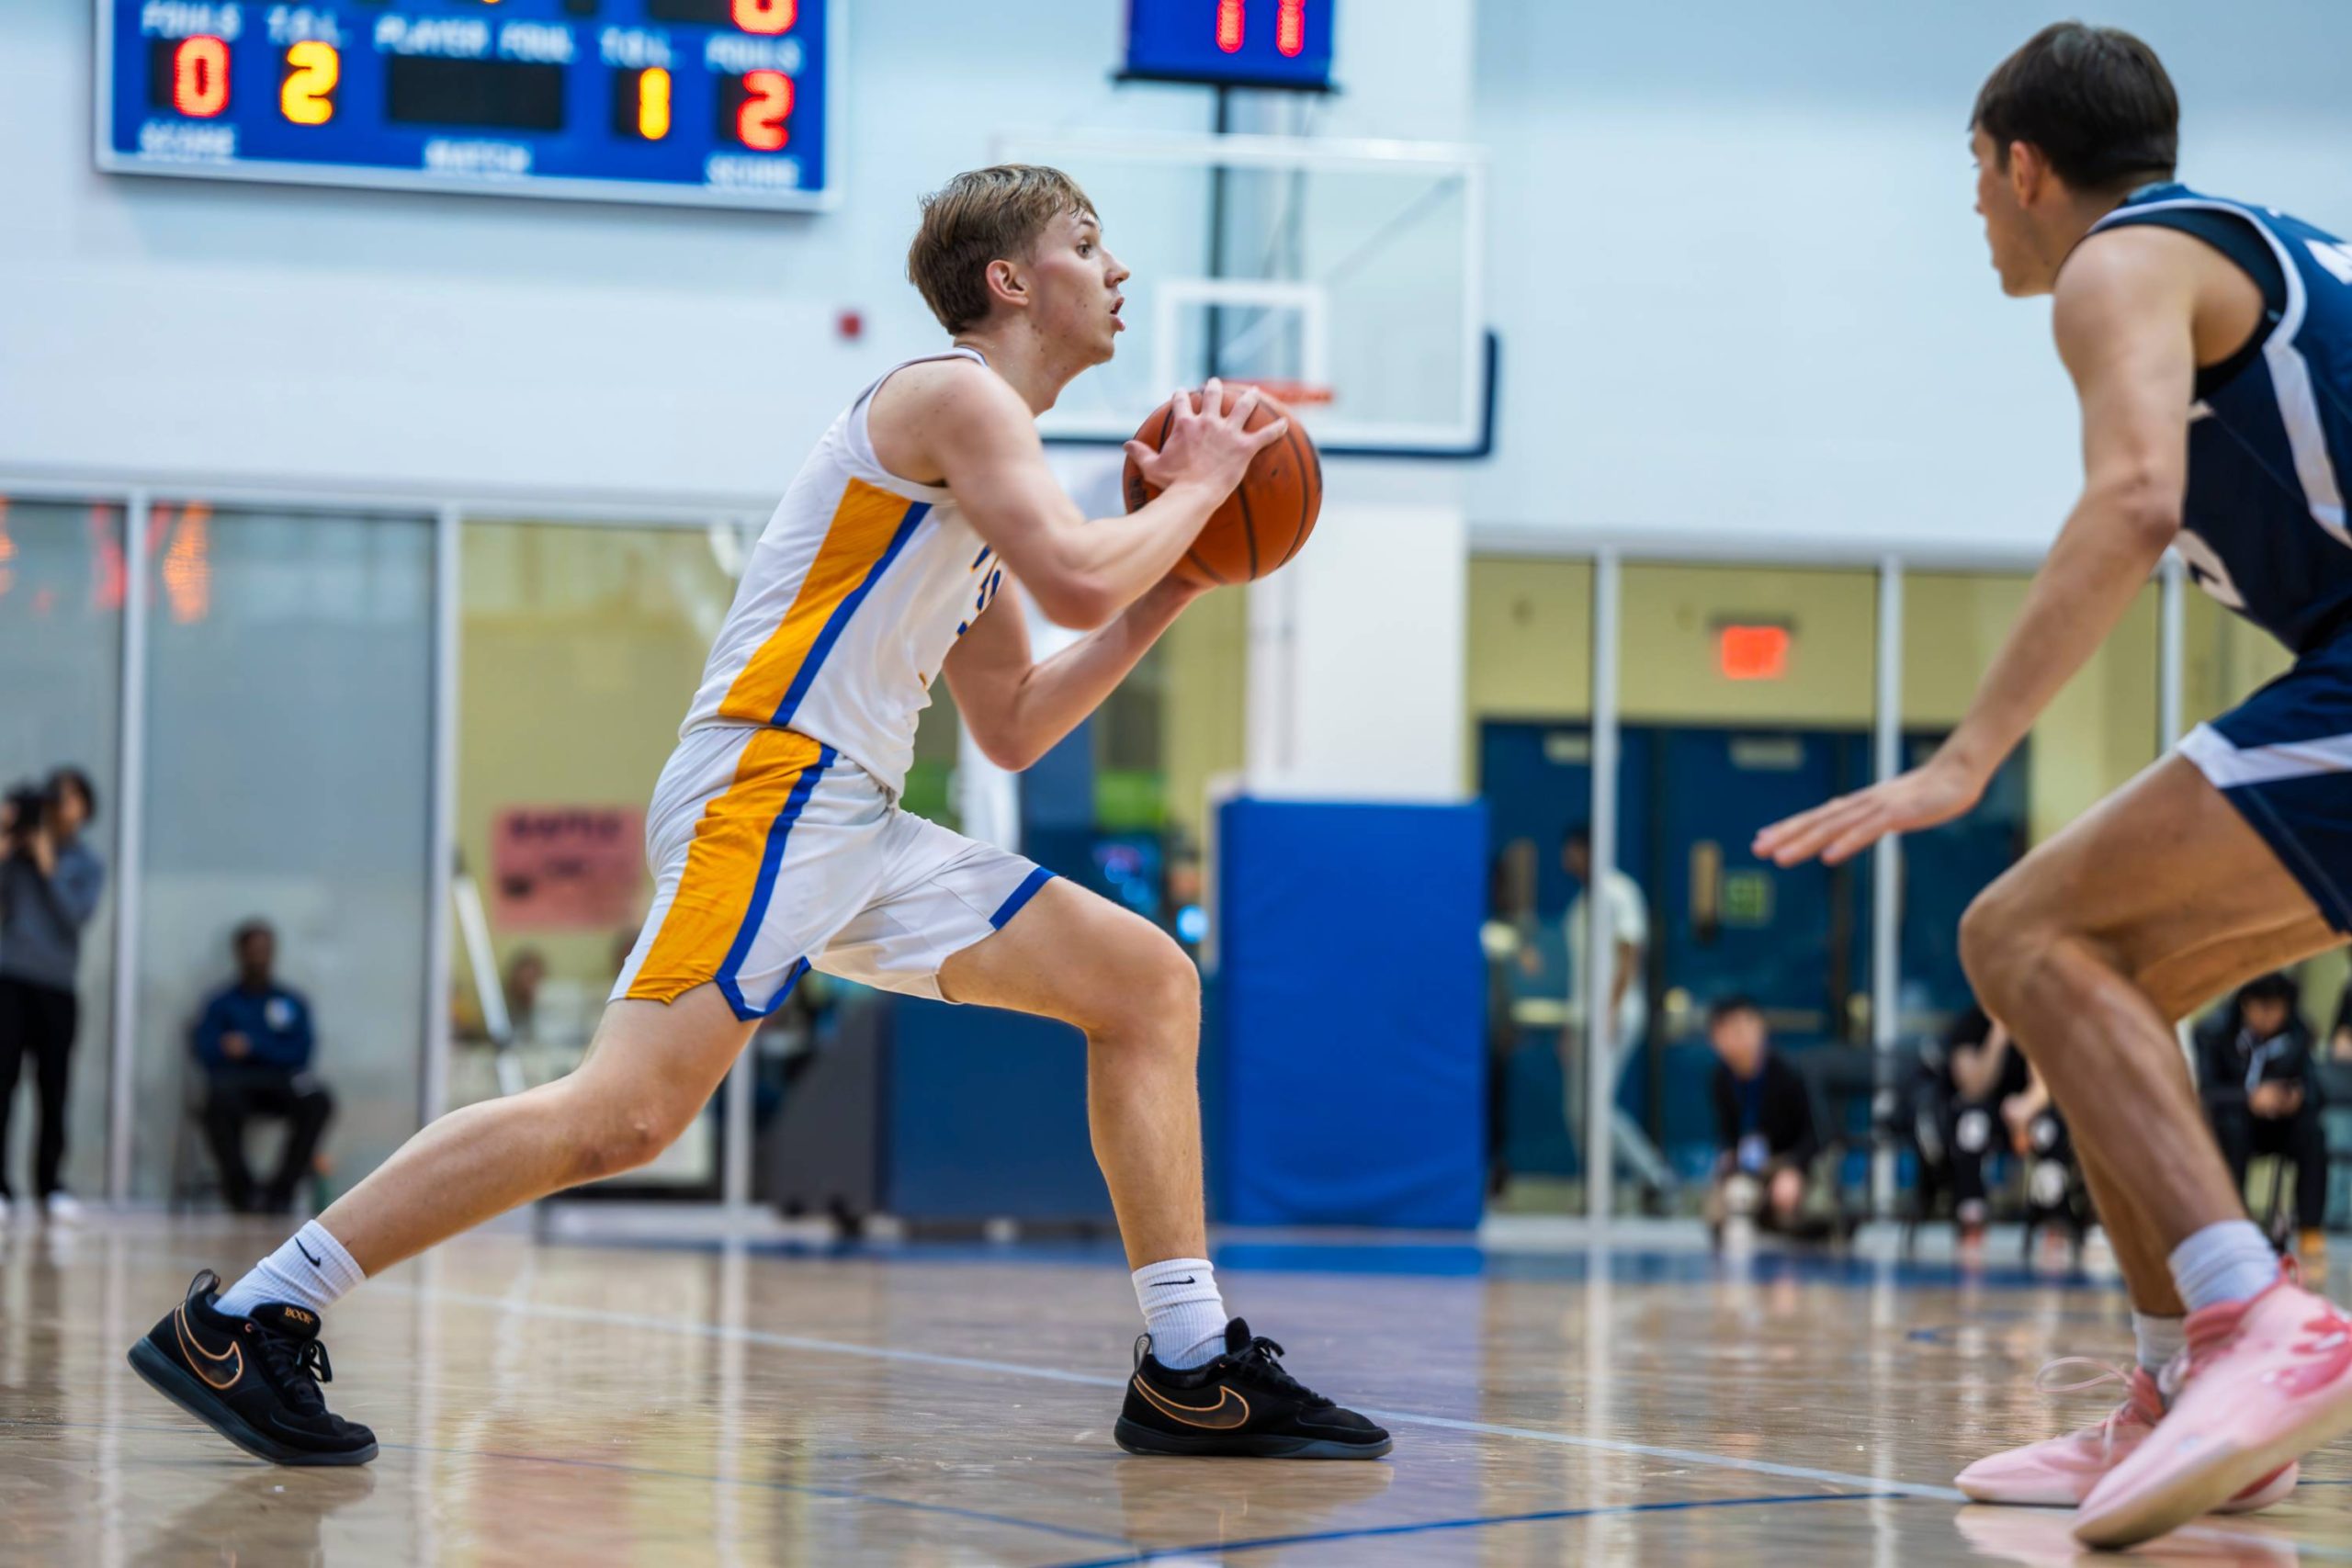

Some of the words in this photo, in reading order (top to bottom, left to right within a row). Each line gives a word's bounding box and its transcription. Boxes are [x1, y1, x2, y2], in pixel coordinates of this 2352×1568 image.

[173, 34, 231, 118] 0
[375, 15, 489, 58] PLAYER
[281, 40, 340, 125] 2
[639, 66, 671, 140] 1
[736, 69, 795, 151] 2
